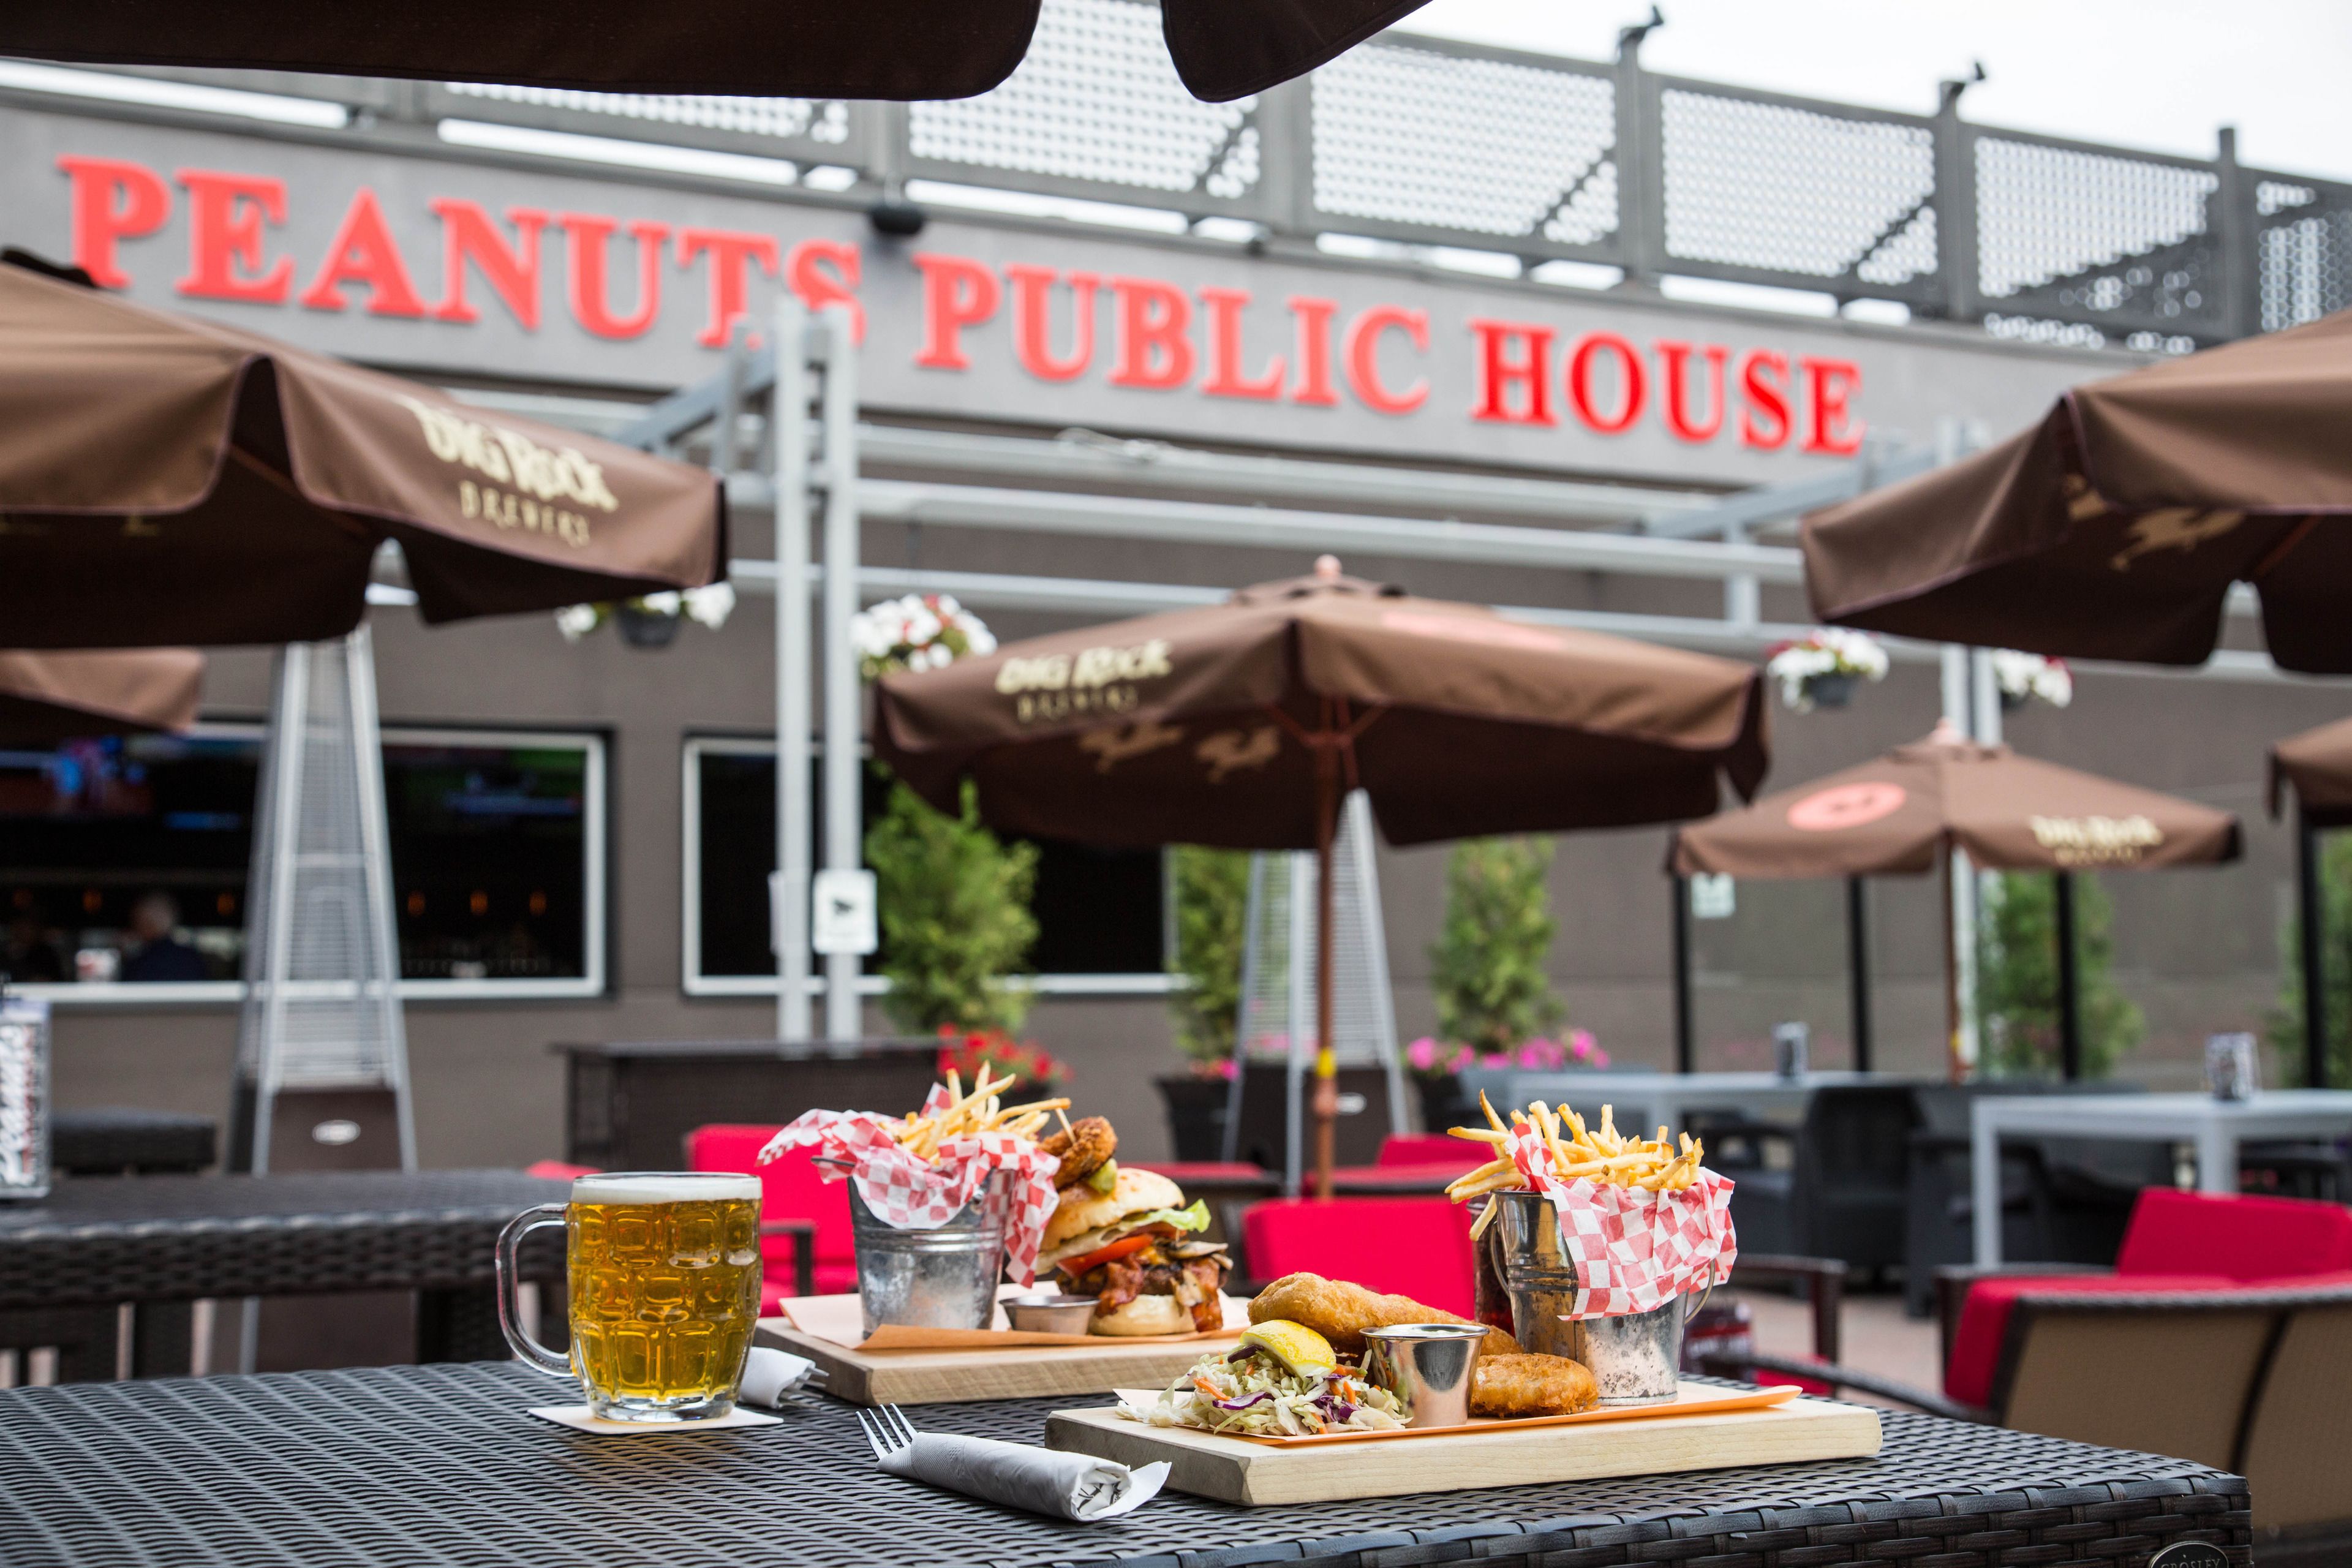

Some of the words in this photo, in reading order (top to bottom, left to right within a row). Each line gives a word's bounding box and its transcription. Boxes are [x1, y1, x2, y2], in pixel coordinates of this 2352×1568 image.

[56, 153, 866, 348] PEANUTS
[912, 252, 1431, 415] PUBLIC
[1468, 317, 1867, 456] HOUSE
